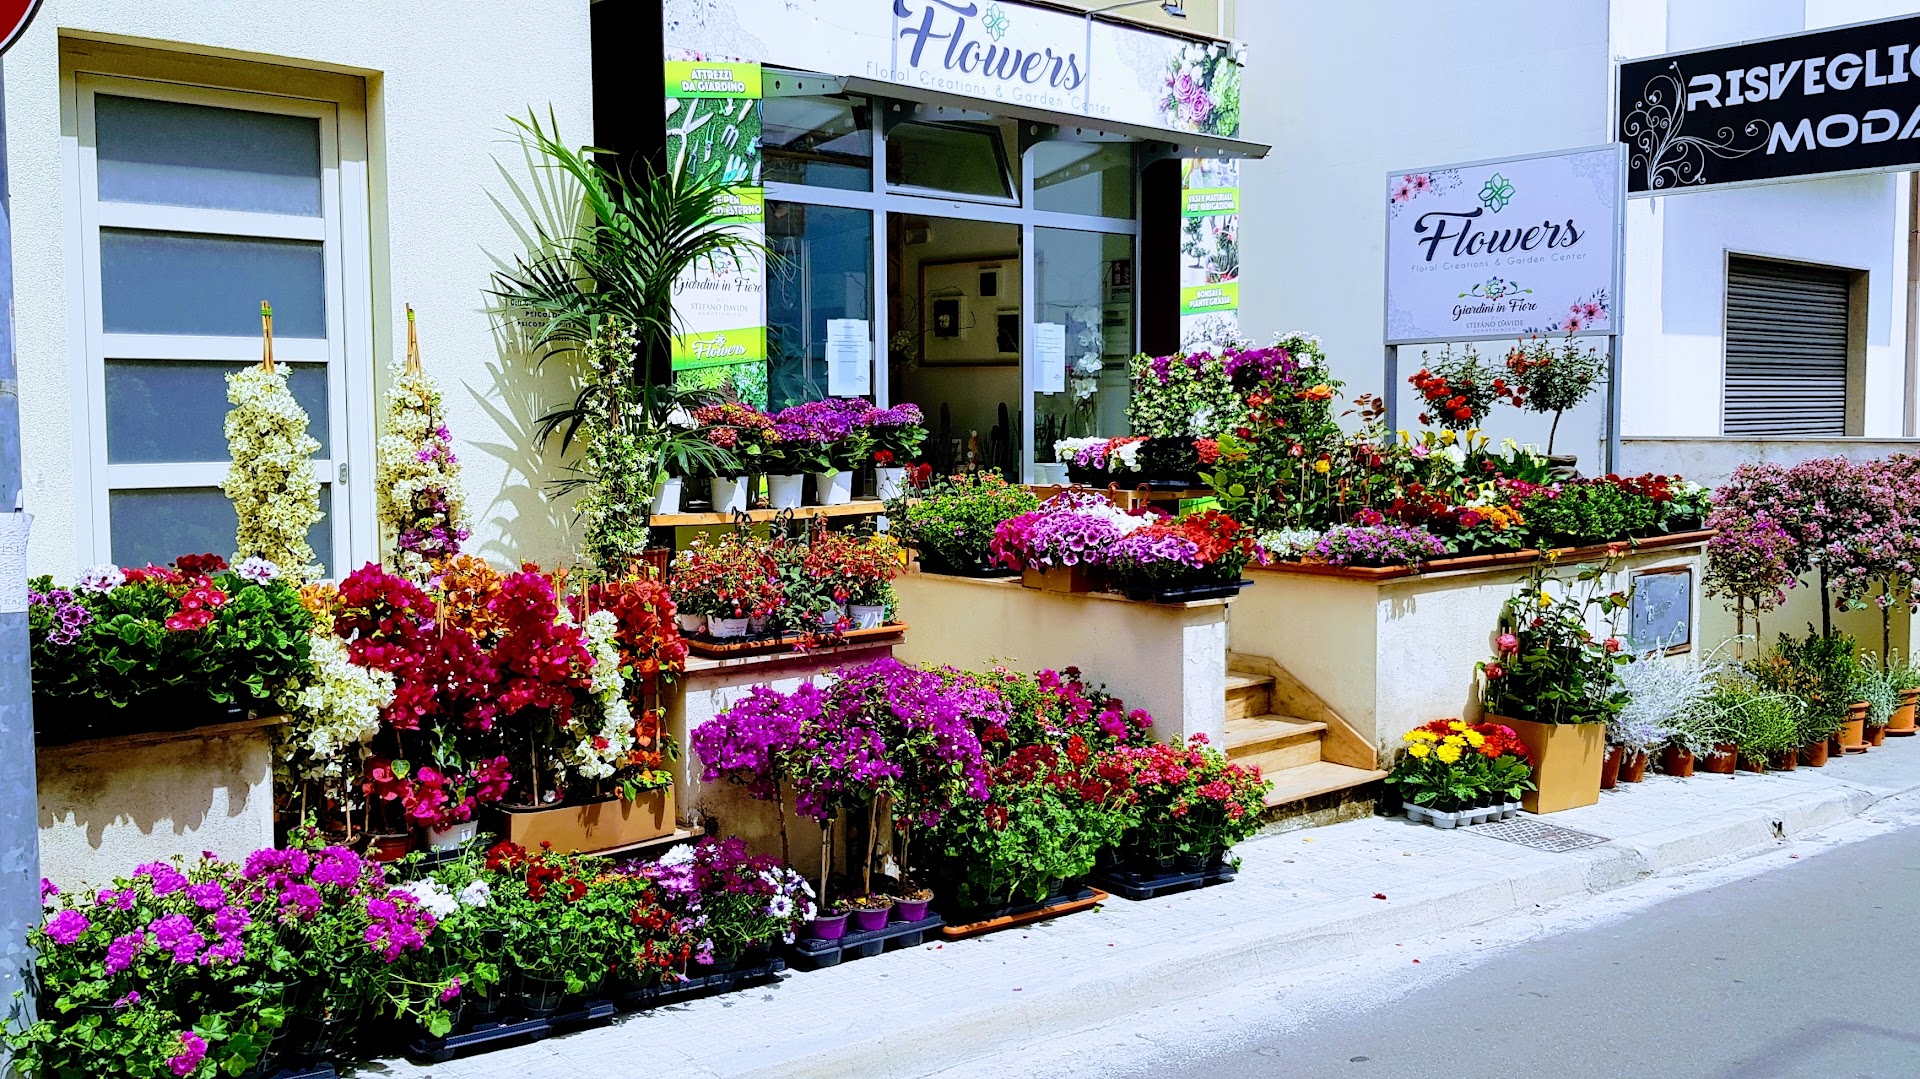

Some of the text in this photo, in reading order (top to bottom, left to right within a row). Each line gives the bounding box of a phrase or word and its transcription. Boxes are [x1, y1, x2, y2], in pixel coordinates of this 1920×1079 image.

[892, 0, 1087, 91] Flowers
[691, 69, 733, 81] ATTREZZI
[1687, 43, 1920, 112] RISVEGLI
[681, 80, 746, 93] DA GIARDINO
[866, 61, 1112, 115] Floral Creations & Garden Center
[1414, 206, 1585, 262] Flowers
[1442, 259, 1489, 271] Creations
[1494, 259, 1501, 267] &
[1507, 255, 1545, 266] Garden
[1551, 252, 1587, 263] Center
[674, 276, 763, 296] Giardini in Fiore
[691, 303, 748, 313] STEFANO DAVIDE
[1452, 298, 1538, 321] Giardini in Fiore
[1465, 319, 1524, 329] STEFANO DAVIDE
[691, 339, 747, 360] Flowers
